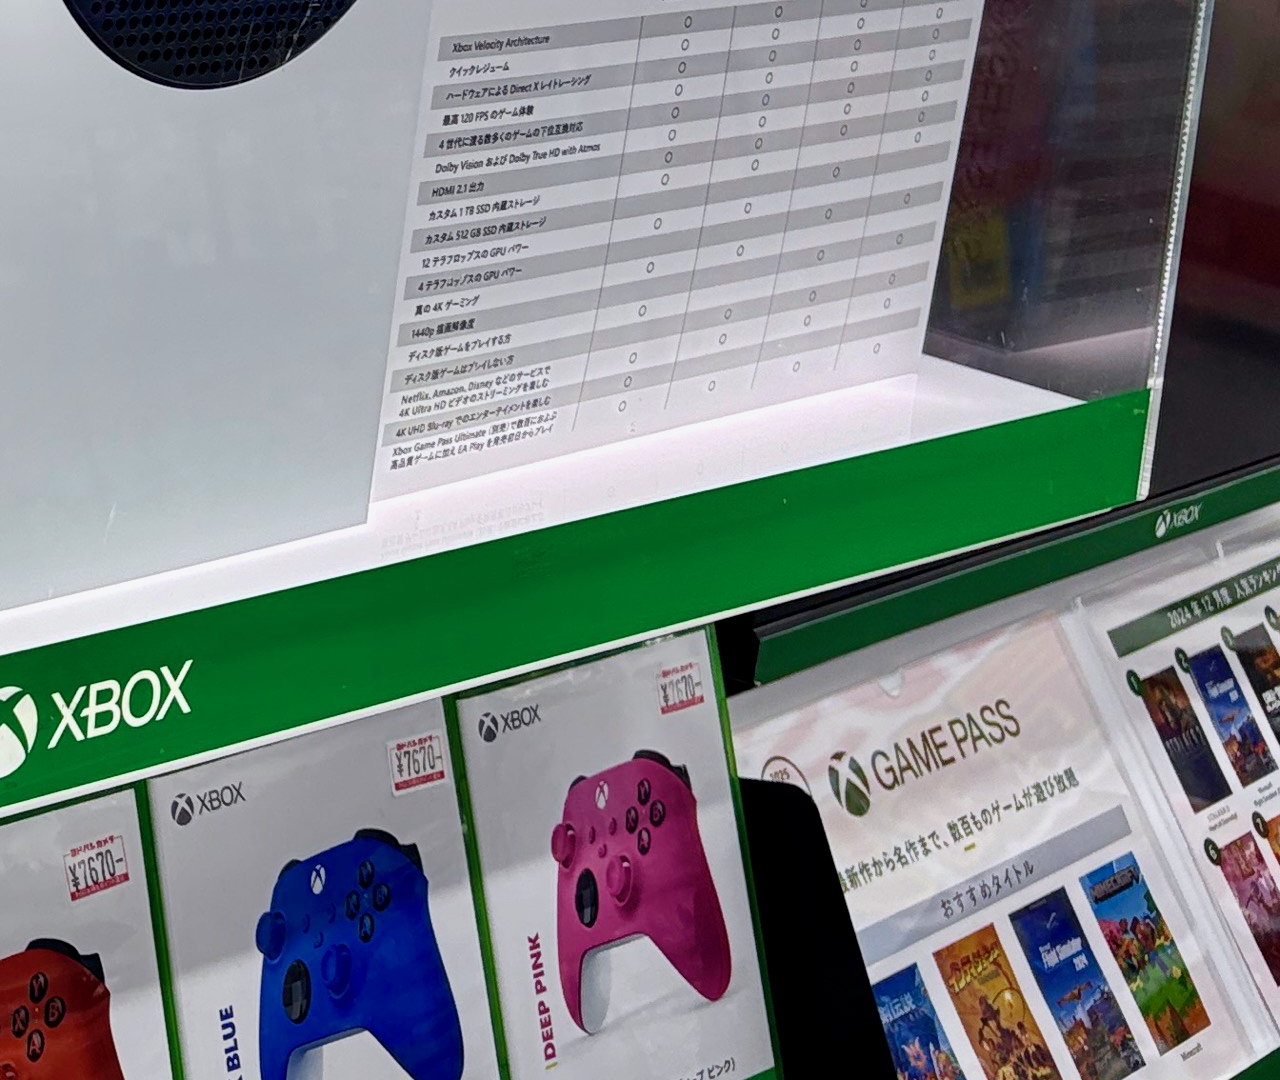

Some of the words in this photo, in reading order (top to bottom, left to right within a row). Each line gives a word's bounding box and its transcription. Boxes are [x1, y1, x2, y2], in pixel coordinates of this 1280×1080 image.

[452, 42, 473, 53] Xbox
[474, 38, 504, 52] Velocity
[505, 34, 550, 48] Architecture
[448, 61, 510, 78] クイックレジューム
[445, 84, 509, 101] ハードウェアによる
[510, 83, 532, 95] Direct
[540, 74, 592, 91] レイトレーシング
[442, 114, 459, 126] 最高
[460, 112, 474, 124] 120
[475, 110, 489, 122] FPS
[490, 104, 535, 120] のゲーム体験
[434, 163, 459, 175] Dolby
[460, 159, 484, 171] Vision
[485, 153, 509, 168] および
[508, 152, 532, 166] Dolby
[532, 149, 549, 161] True
[548, 147, 561, 159] HD
[561, 145, 578, 157] with
[578, 142, 602, 154] Atmos
[431, 184, 456, 198] HDMI
[456, 182, 468, 195] 2.1
[469, 180, 486, 193] 出力
[428, 208, 458, 222] カスタム
[465, 205, 476, 217] TB
[476, 202, 491, 215] SSD
[491, 195, 542, 213] 内蔵ストレージ
[424, 231, 454, 246] カスタム
[455, 229, 469, 241] 512
[470, 227, 482, 239] GB
[482, 225, 498, 237] SSD
[498, 216, 547, 235] 内蔵ストレージ
[431, 249, 489, 267] テラフロップスの
[489, 246, 507, 259] GPU
[507, 242, 530, 254] パワー
[483, 269, 500, 282] GPU
[500, 266, 523, 277] パワー
[432, 301, 444, 312] 4K
[445, 294, 480, 312] ゲーミング
[411, 325, 435, 339] 1440p
[467, 380, 495, 393] Disney
[398, 407, 411, 418] 4K
[411, 403, 433, 417] Ultra
[433, 400, 447, 412] HD
[395, 427, 408, 438] 4K
[407, 423, 426, 436] UHD
[426, 419, 453, 433] Blu-ray
[392, 445, 413, 458] Xbox
[413, 440, 436, 454] Game
[436, 436, 454, 448] Pass
[453, 428, 487, 444] Ultimate
[469, 441, 485, 453] Play
[46, 660, 194, 750] XBOX
[498, 703, 541, 734] XBOX
[871, 725, 956, 791] GAME
[951, 698, 1022, 760] PASS
[395, 743, 443, 778] ¥7670-
[196, 780, 246, 826] XBOX
[68, 848, 124, 894] ¥7670-
[940, 859, 1035, 919] おすすめタイトル
[526, 932, 547, 995] PINK
[218, 1004, 243, 1073] BLUE
[538, 999, 557, 1061] DEEP
